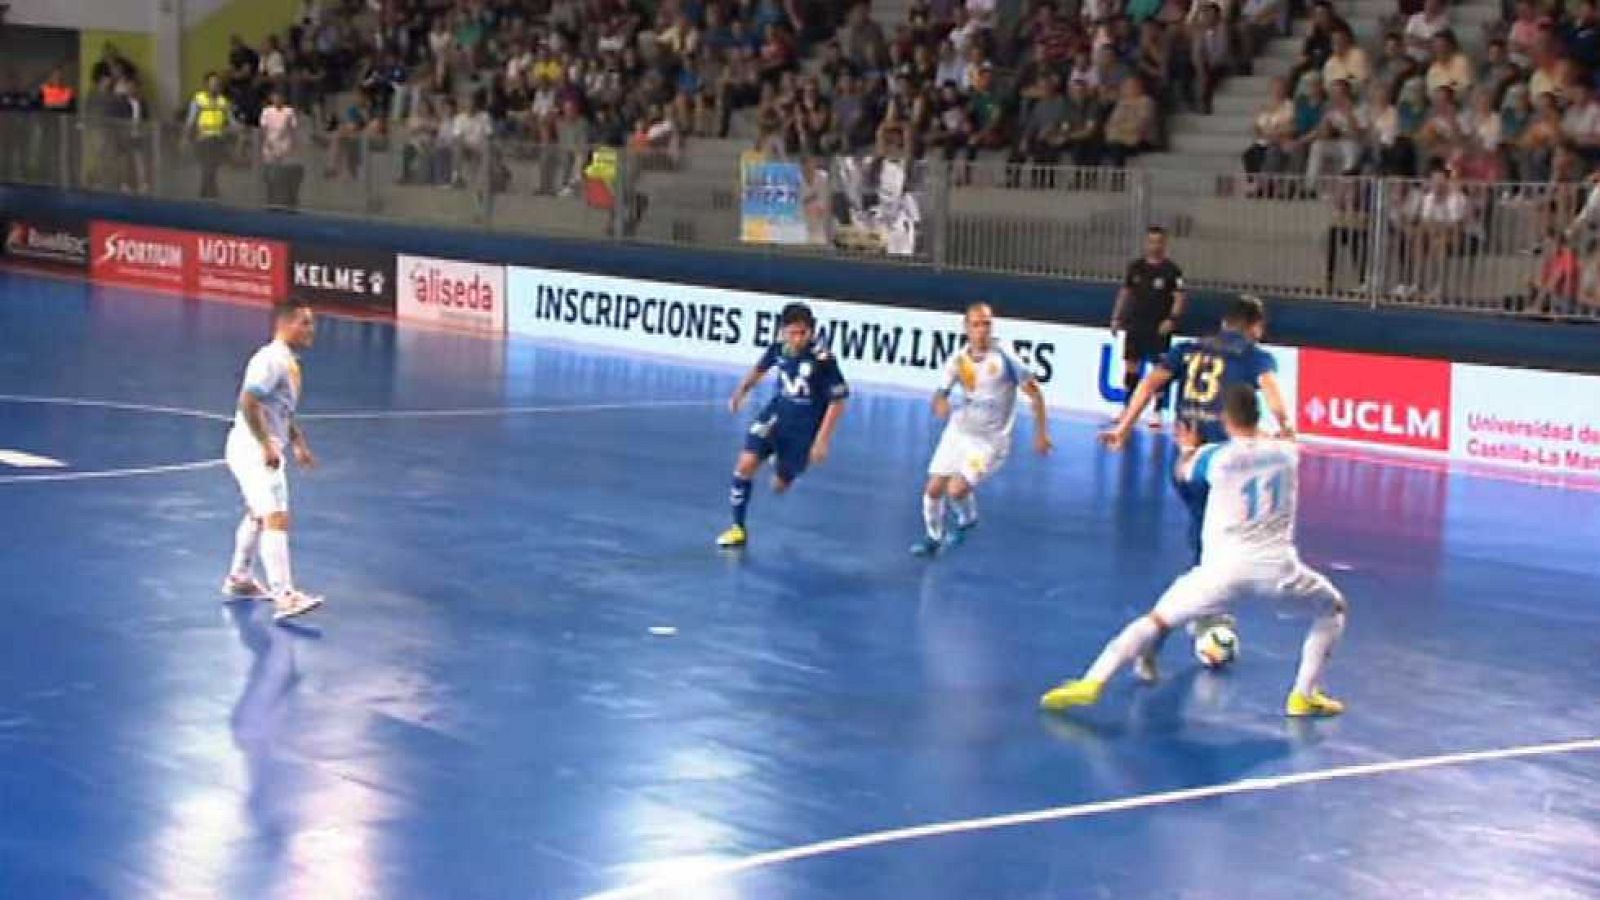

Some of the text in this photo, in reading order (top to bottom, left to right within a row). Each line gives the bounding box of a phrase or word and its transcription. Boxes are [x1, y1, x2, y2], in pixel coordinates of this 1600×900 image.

[294, 261, 367, 294] KELME
[415, 267, 493, 311] aliseda
[536, 284, 742, 344] INSCRIPCIONES
[754, 311, 782, 347] E
[1183, 352, 1224, 402] 13
[1329, 397, 1441, 440] UCLM
[1468, 411, 1573, 441] Universidad
[1240, 469, 1287, 521] 11
